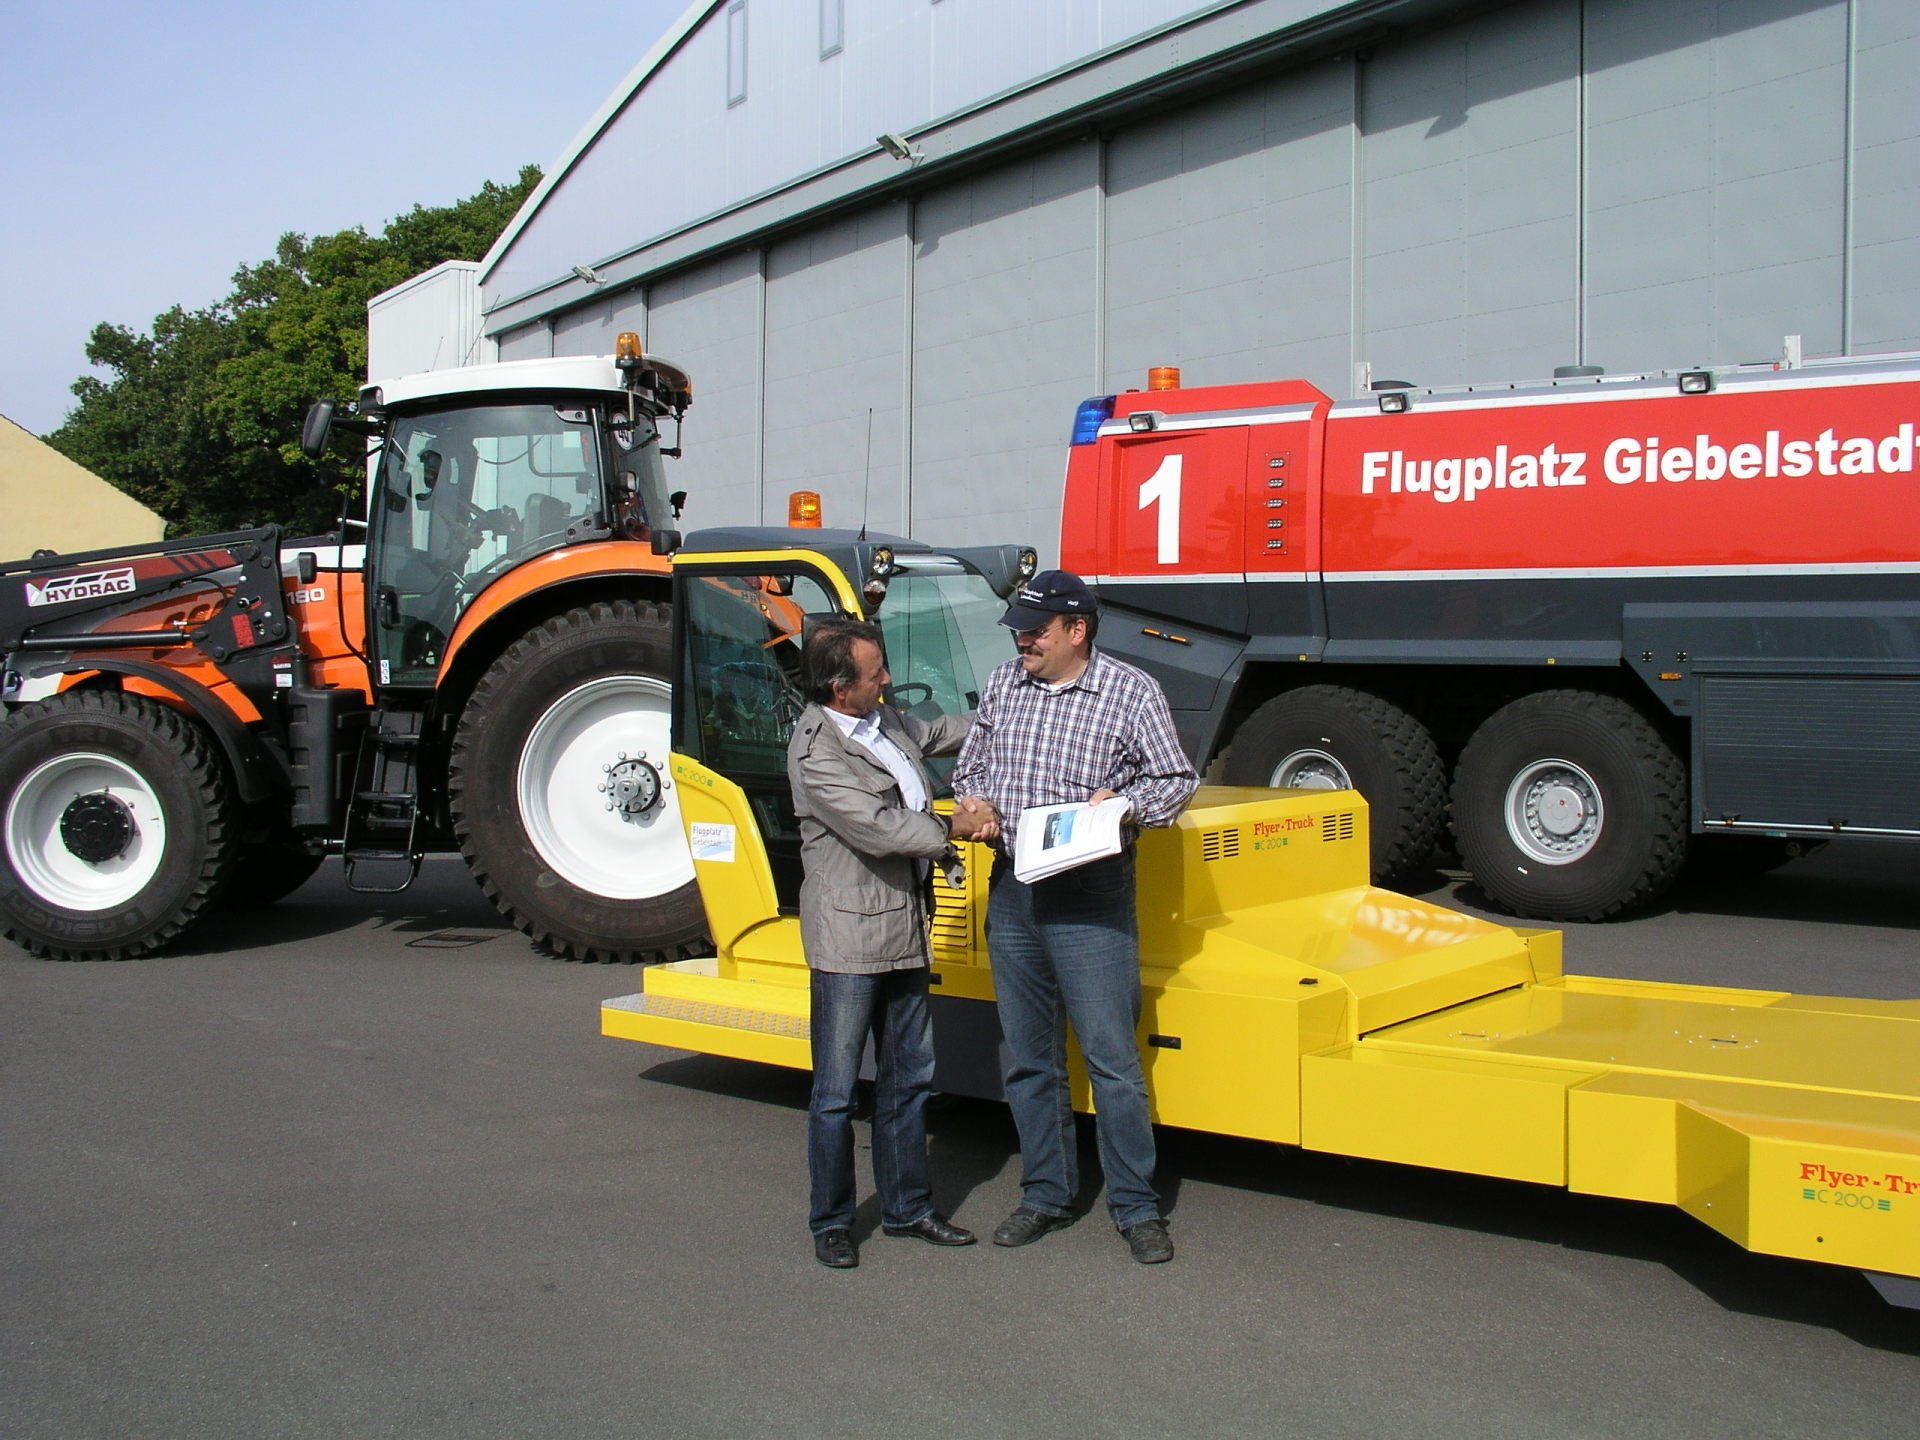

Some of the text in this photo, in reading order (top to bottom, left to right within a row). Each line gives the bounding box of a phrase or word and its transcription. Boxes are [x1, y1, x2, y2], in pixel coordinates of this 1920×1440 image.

[1361, 423, 1920, 503] Flugplatz Giebelstad
[1138, 453, 1183, 565] 1
[45, 579, 130, 603] HYDRAC
[286, 587, 326, 605] 180
